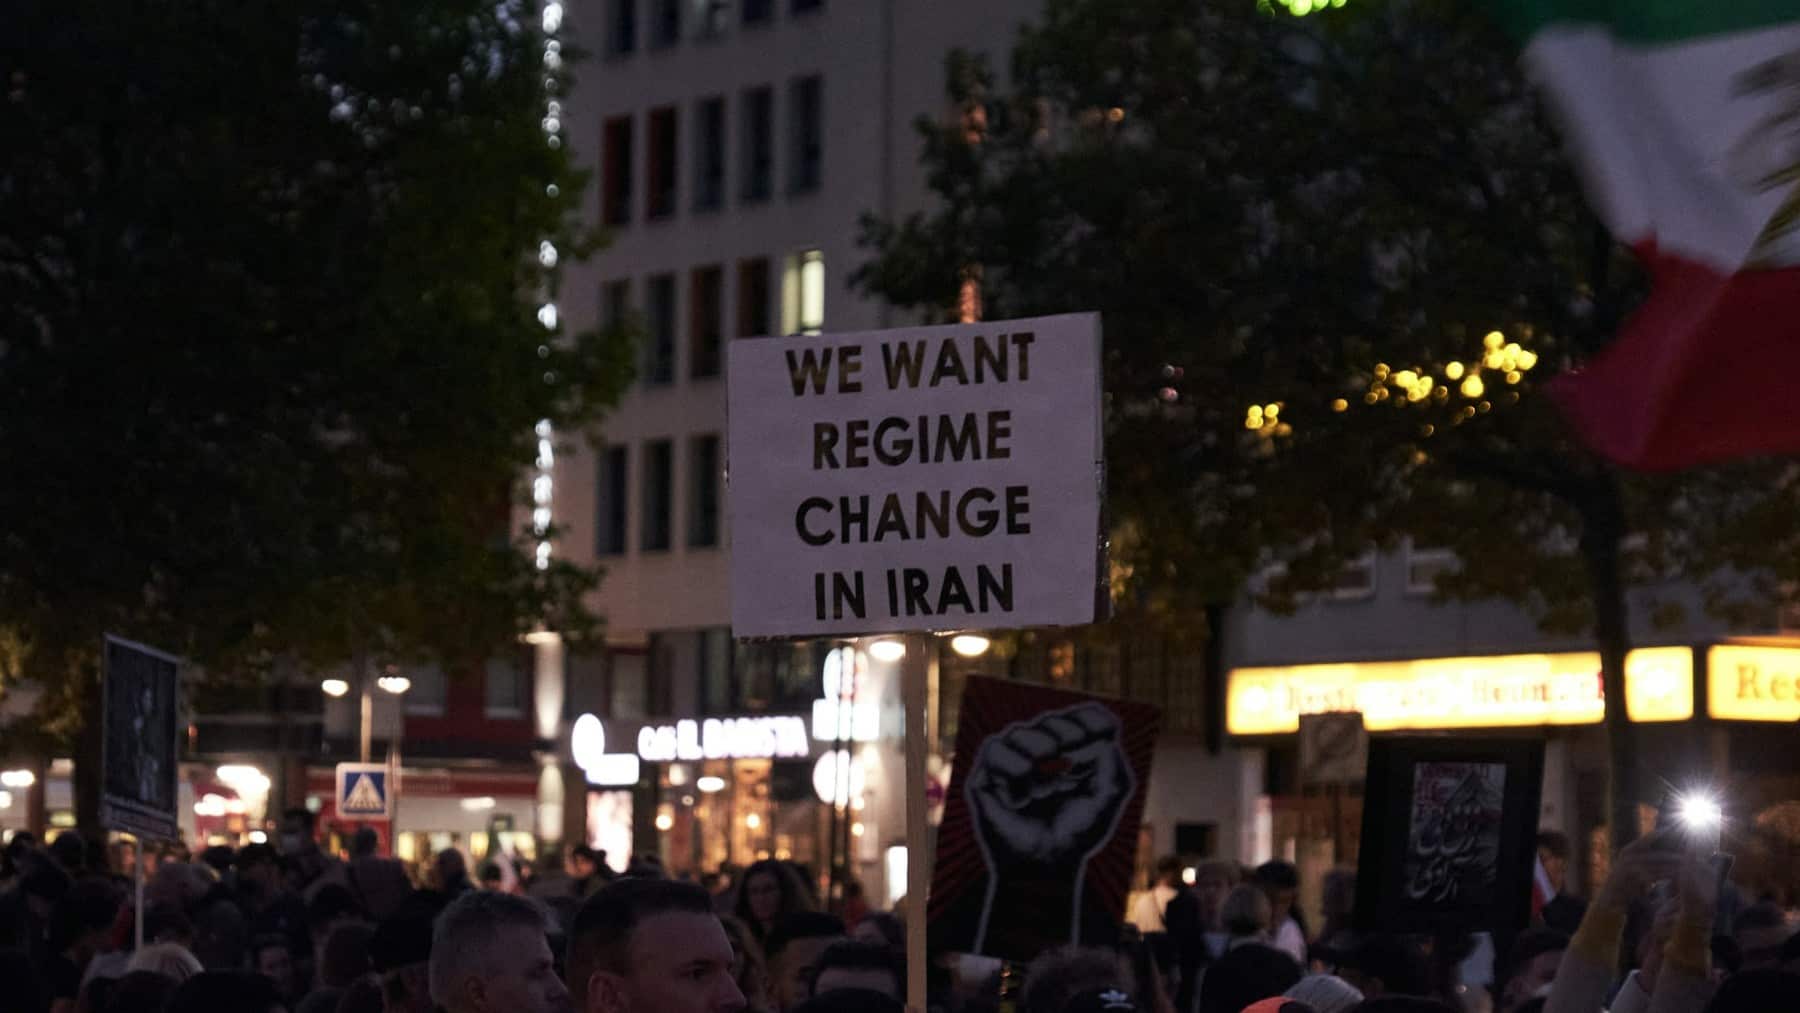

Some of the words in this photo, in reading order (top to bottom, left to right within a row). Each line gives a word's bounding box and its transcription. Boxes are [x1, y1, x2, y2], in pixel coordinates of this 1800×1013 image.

[786, 346, 862, 396] WE
[881, 332, 1035, 390] WANT
[813, 410, 1011, 470] REGIME
[796, 486, 1030, 546] CHANGE
[815, 571, 866, 620] IN
[887, 564, 1013, 617] IRAN
